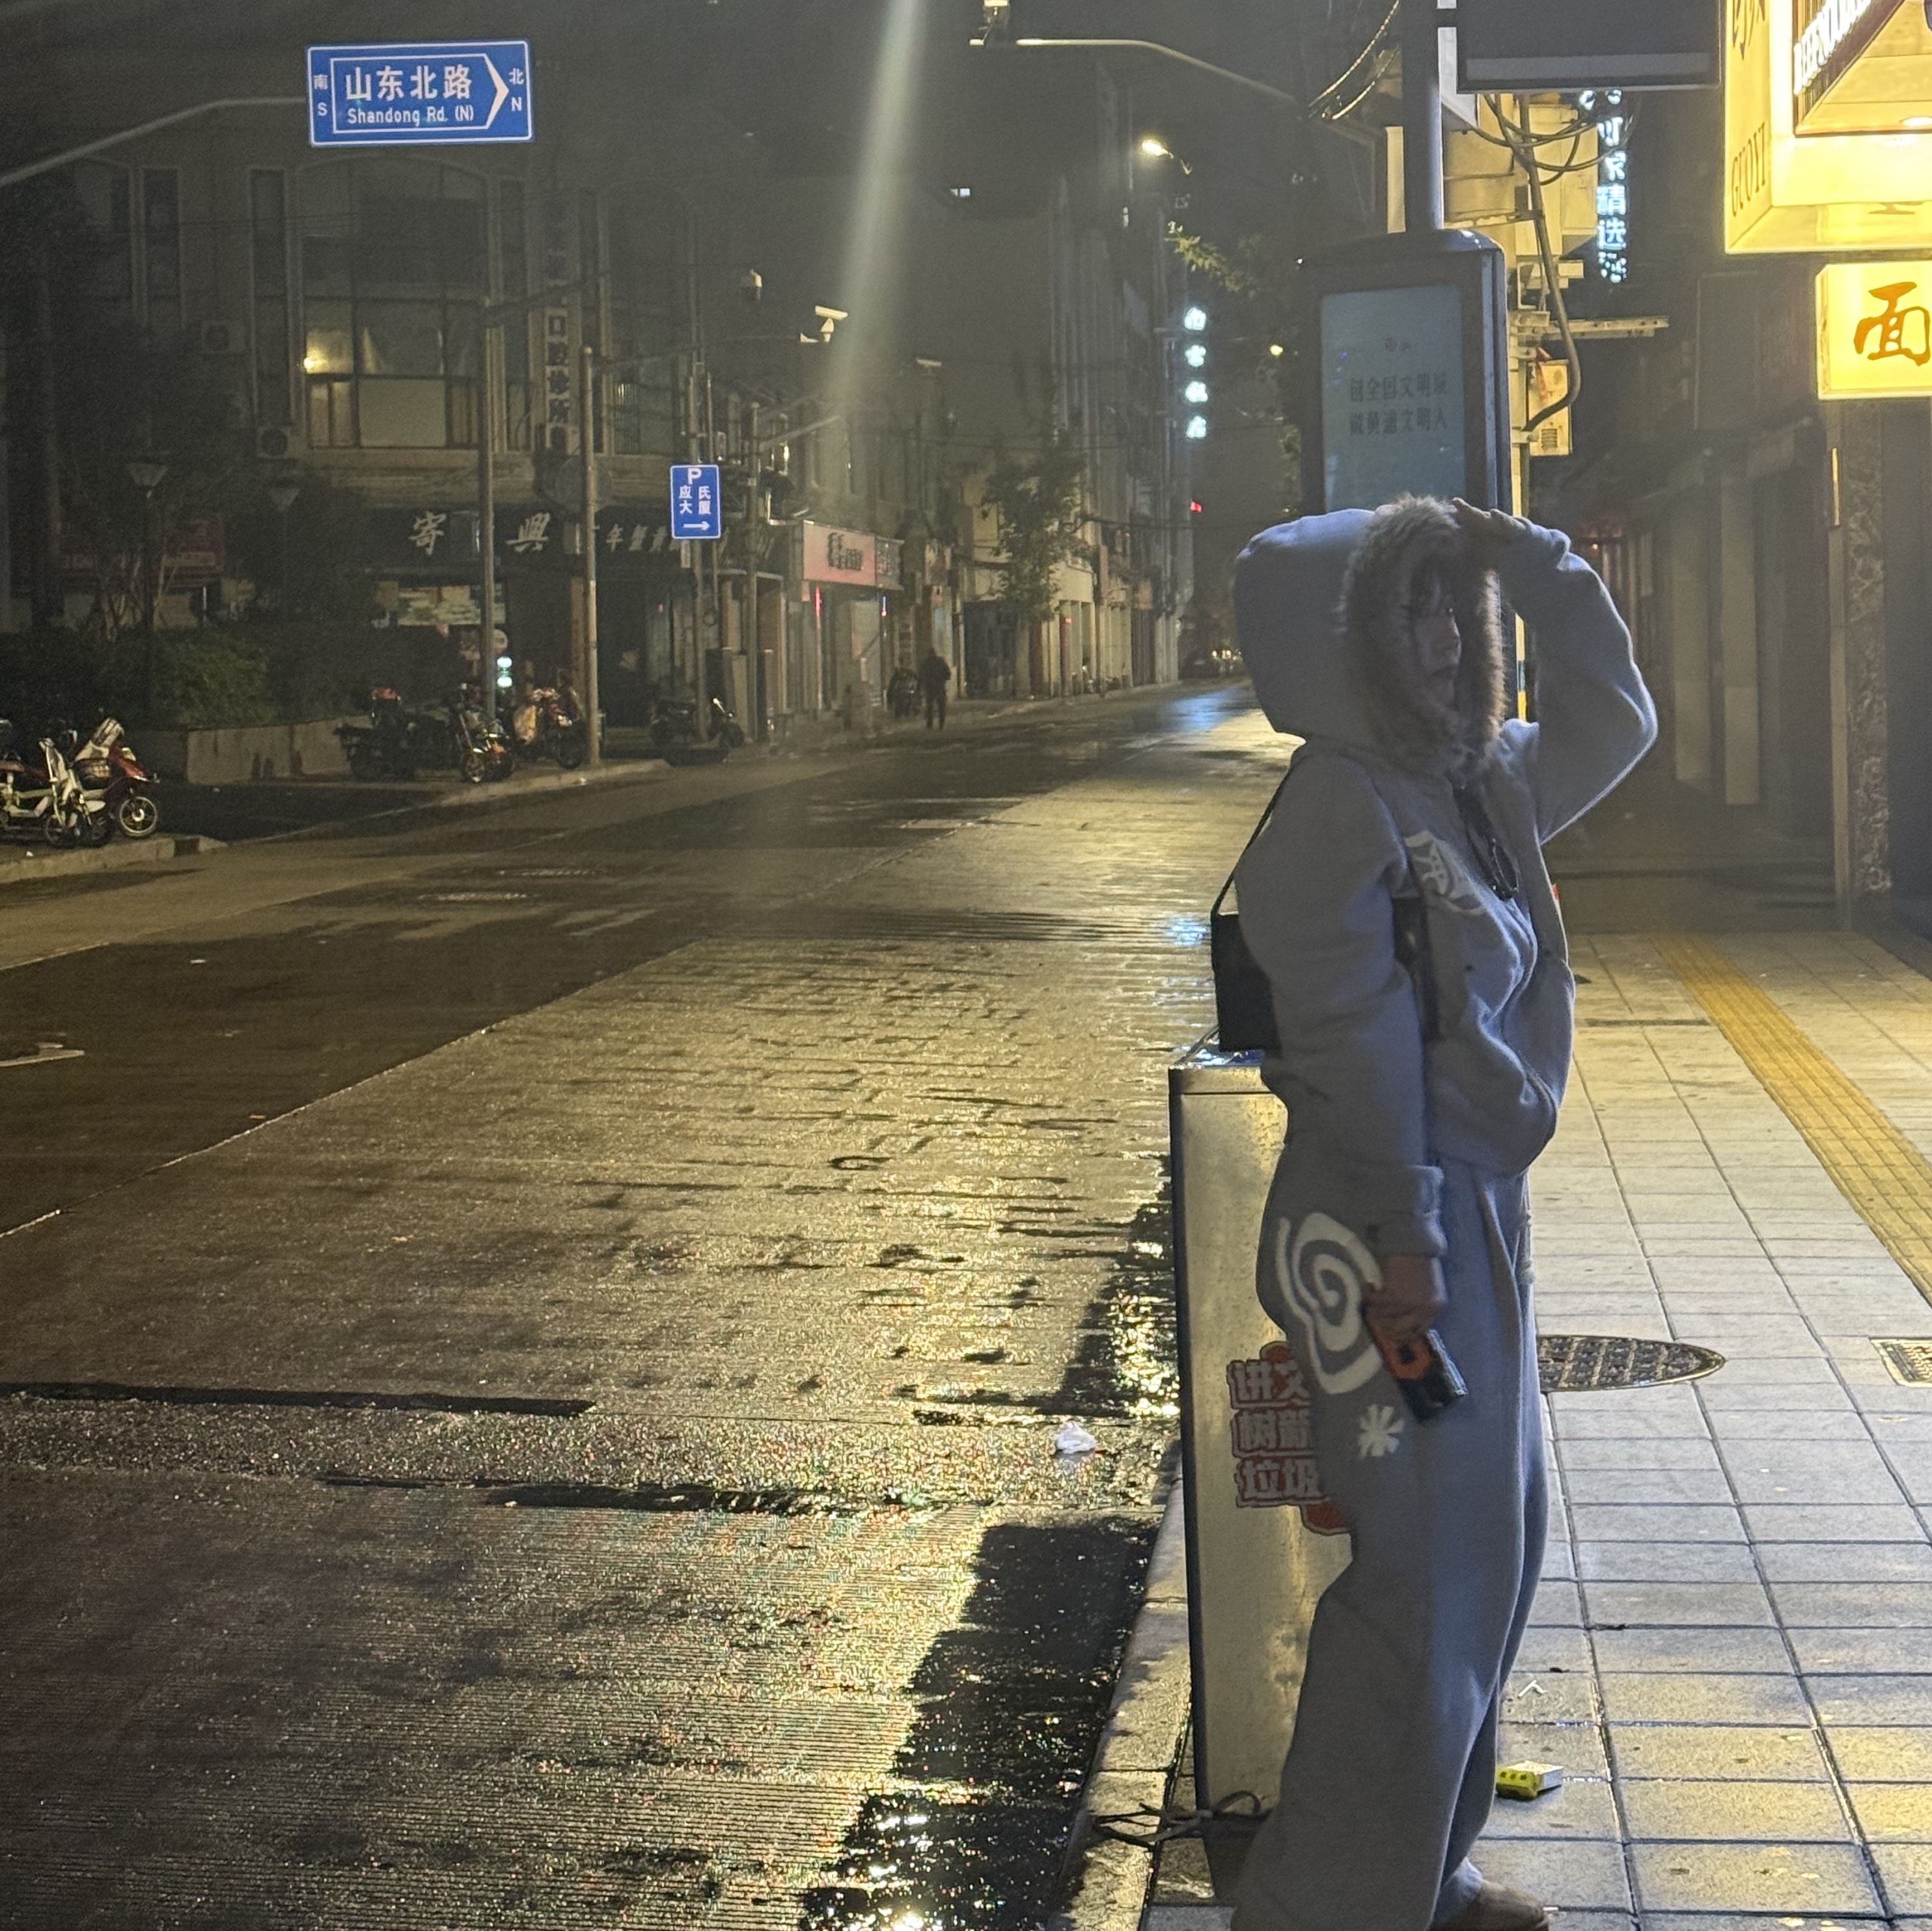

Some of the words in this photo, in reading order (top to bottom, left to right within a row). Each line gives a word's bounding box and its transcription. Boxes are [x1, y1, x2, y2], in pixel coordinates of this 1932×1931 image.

[313, 74, 328, 90] 南
[345, 64, 472, 102] 山东北路
[509, 68, 524, 85] 北
[317, 102, 327, 116] S
[511, 98, 522, 111] N
[348, 106, 420, 127] Shandong
[455, 104, 474, 122] (N)
[1853, 281, 1931, 367] 面
